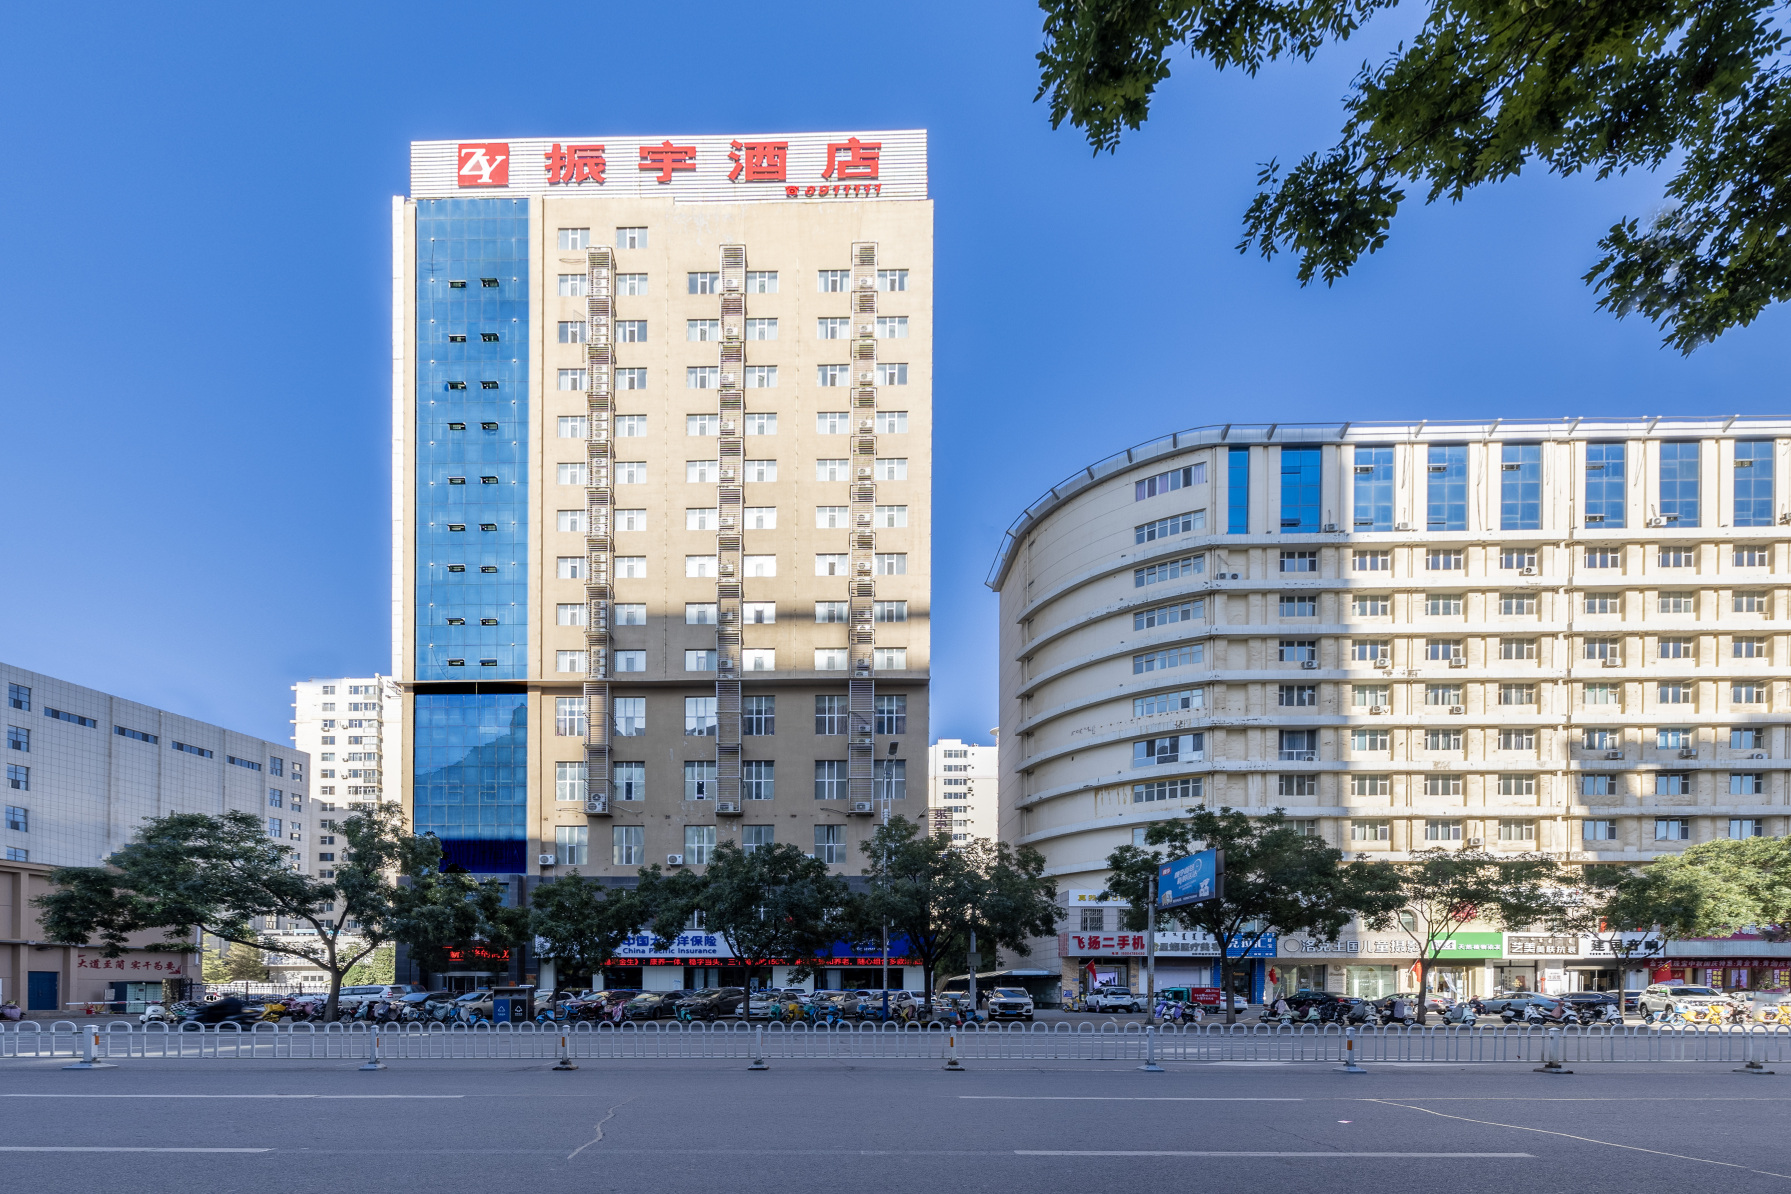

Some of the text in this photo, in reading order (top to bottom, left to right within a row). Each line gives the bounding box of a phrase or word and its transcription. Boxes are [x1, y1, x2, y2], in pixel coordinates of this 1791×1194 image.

[459, 148, 506, 183] ZY
[545, 137, 882, 185] 振宇酒店
[622, 936, 717, 946] 中国洋保险
[1072, 935, 1146, 950] 飞扬二手机
